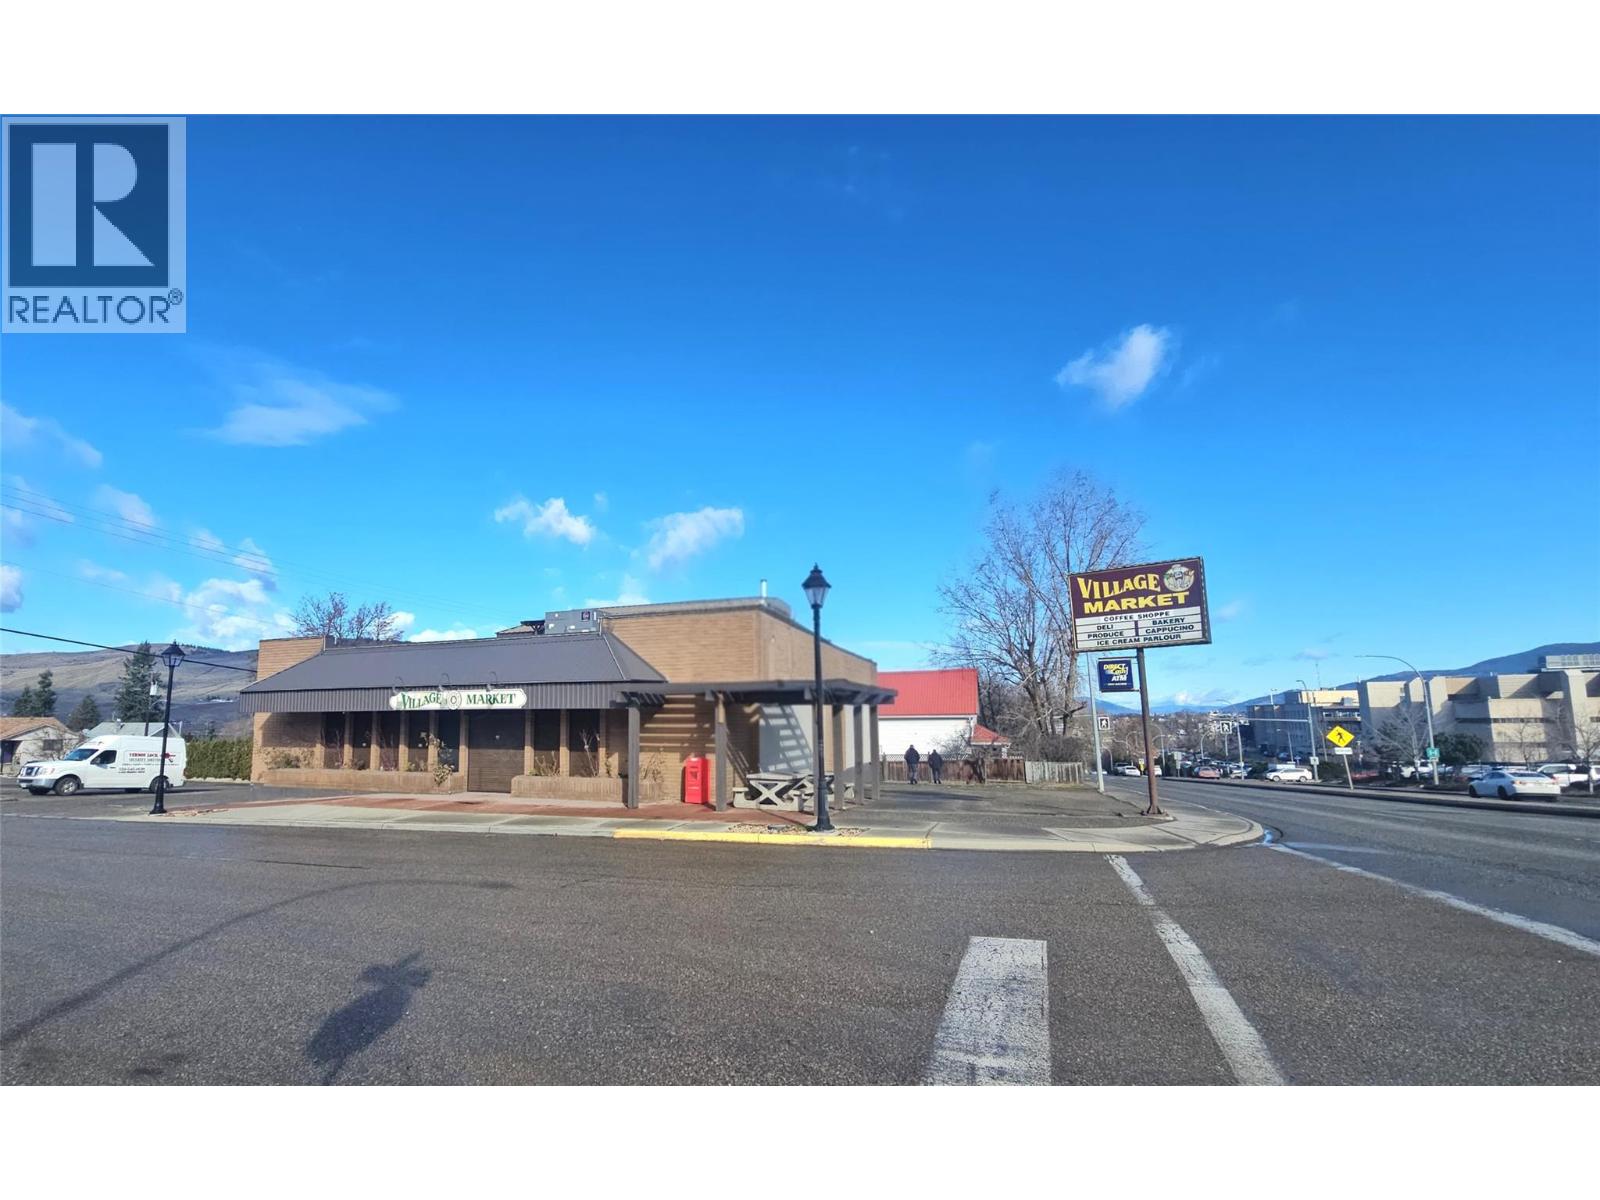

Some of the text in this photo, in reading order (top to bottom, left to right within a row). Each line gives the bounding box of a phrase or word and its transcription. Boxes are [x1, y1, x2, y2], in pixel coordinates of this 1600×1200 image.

[1077, 573, 1161, 599] VILLAGE
[1083, 591, 1189, 614] MARKET
[1104, 611, 1170, 622] COFFEE SHOPPE
[1152, 617, 1185, 626] BAKERY
[1145, 624, 1194, 634] CAPPUCINO
[1087, 631, 1124, 639] PRODUCE
[1112, 637, 1140, 645] CREAM
[1143, 634, 1181, 643] PARLOUR
[401, 692, 516, 709] VILLAGE MARKET
